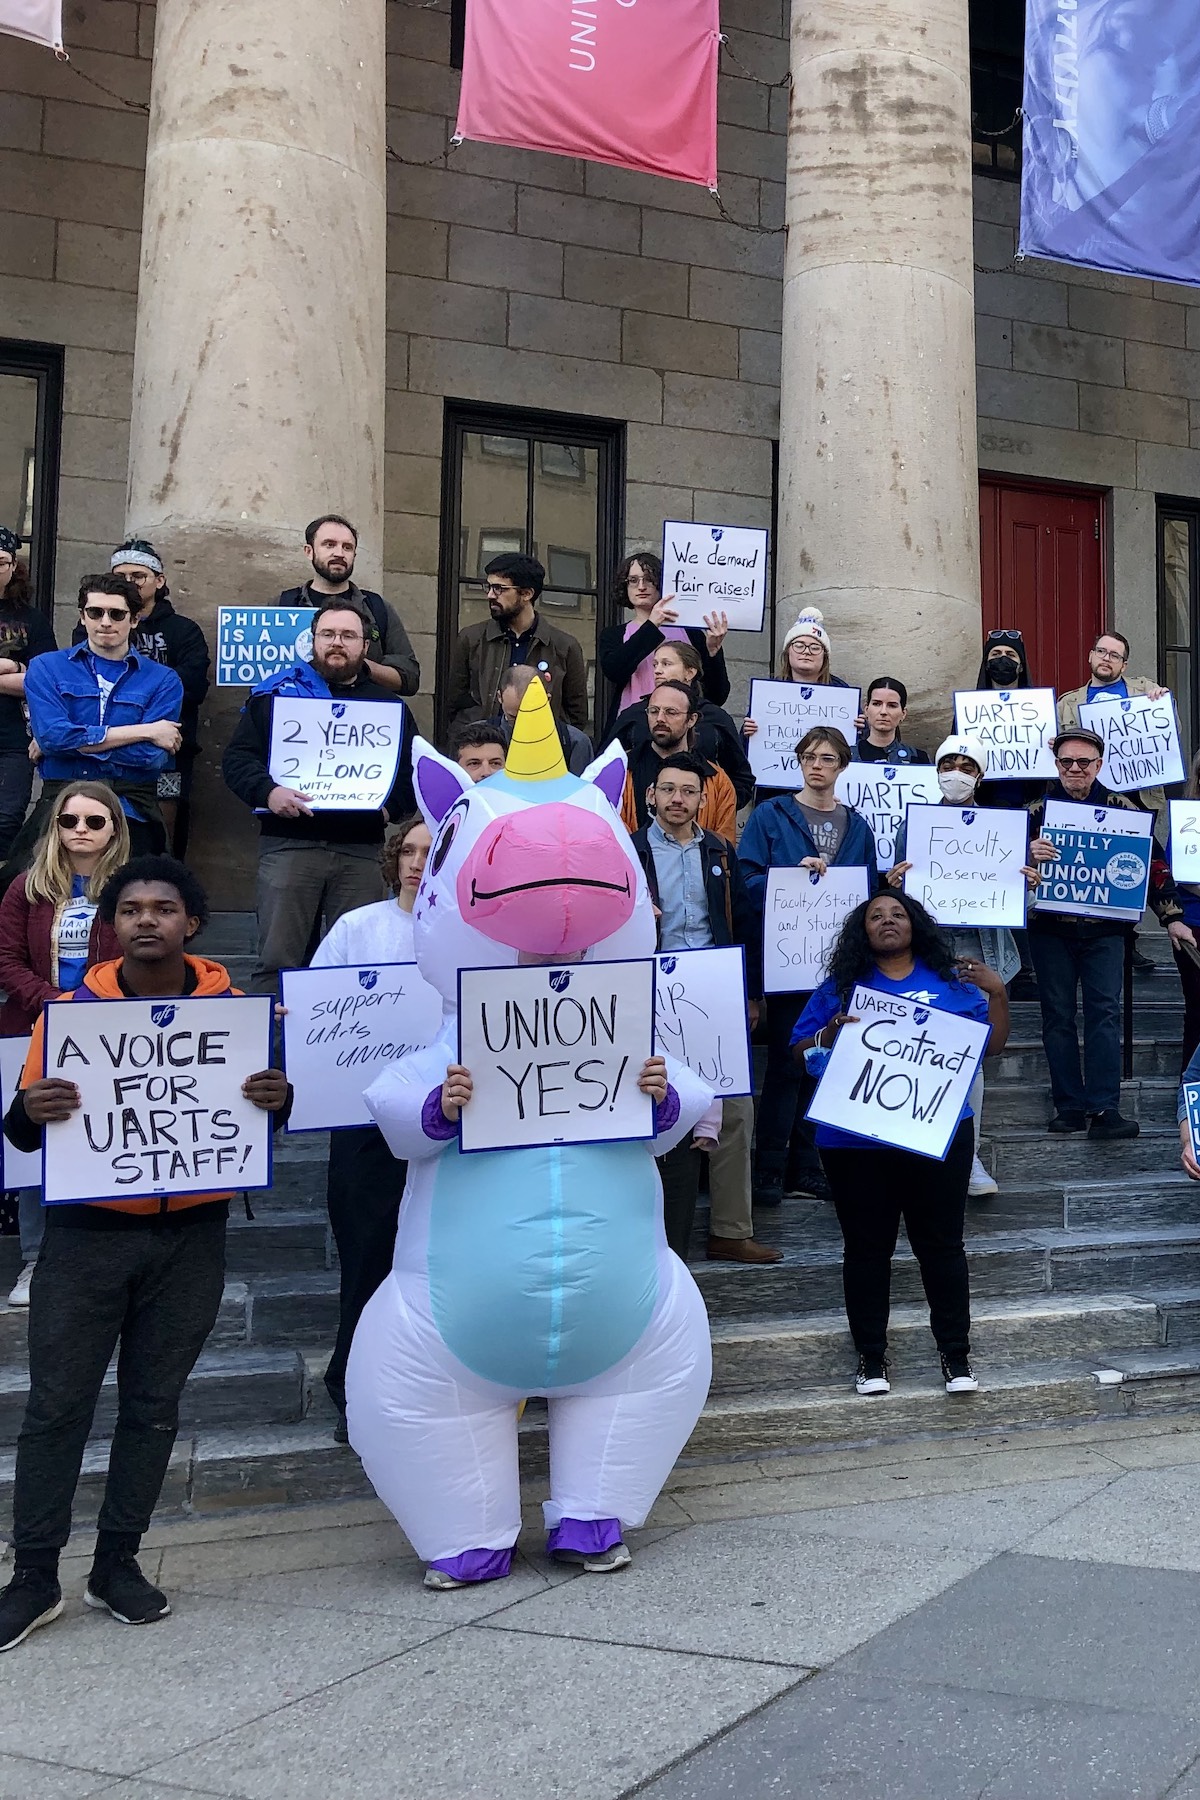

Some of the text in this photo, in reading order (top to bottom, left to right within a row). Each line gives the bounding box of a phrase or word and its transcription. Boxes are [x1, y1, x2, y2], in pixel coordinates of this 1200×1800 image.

[1053, 0, 1079, 141] TIVITY
[672, 541, 758, 569] We demand
[671, 569, 755, 597] fair raises!
[221, 613, 300, 626] PHILLY
[224, 629, 271, 642] IS A
[221, 645, 295, 661] UNION
[221, 662, 293, 682] TOW
[767, 700, 850, 720] STUDENTS
[964, 702, 1039, 724] UARTS
[1091, 707, 1170, 741] UARTS
[282, 720, 392, 748] 2 YEARS
[763, 741, 796, 750] DESE
[1107, 732, 1172, 763] ACULTY
[280, 757, 382, 780] 2 LONG
[320, 749, 336, 760] IS
[1109, 756, 1165, 785] UNION!
[299, 782, 332, 791] WITH
[846, 782, 929, 810] UARTS
[928, 826, 1012, 864] Faculty
[1044, 832, 1112, 850] PHILLY
[1052, 849, 1086, 864] S A
[930, 861, 998, 881] Deserve
[1040, 862, 1106, 884] UNION
[922, 885, 1005, 914] Respect!
[1040, 881, 1110, 904] TOWN
[778, 912, 846, 931] and stude
[777, 936, 832, 967] Solida
[855, 993, 907, 1018] UARTS
[480, 993, 618, 1054] UNION
[57, 1030, 230, 1069] A VOICE
[861, 1019, 976, 1075] Contract
[112, 1072, 200, 1106] FOR
[496, 1055, 630, 1120] YES!
[849, 1058, 953, 1124] NOW!
[83, 1108, 241, 1154] UARTS
[111, 1144, 254, 1184] STAFF!
